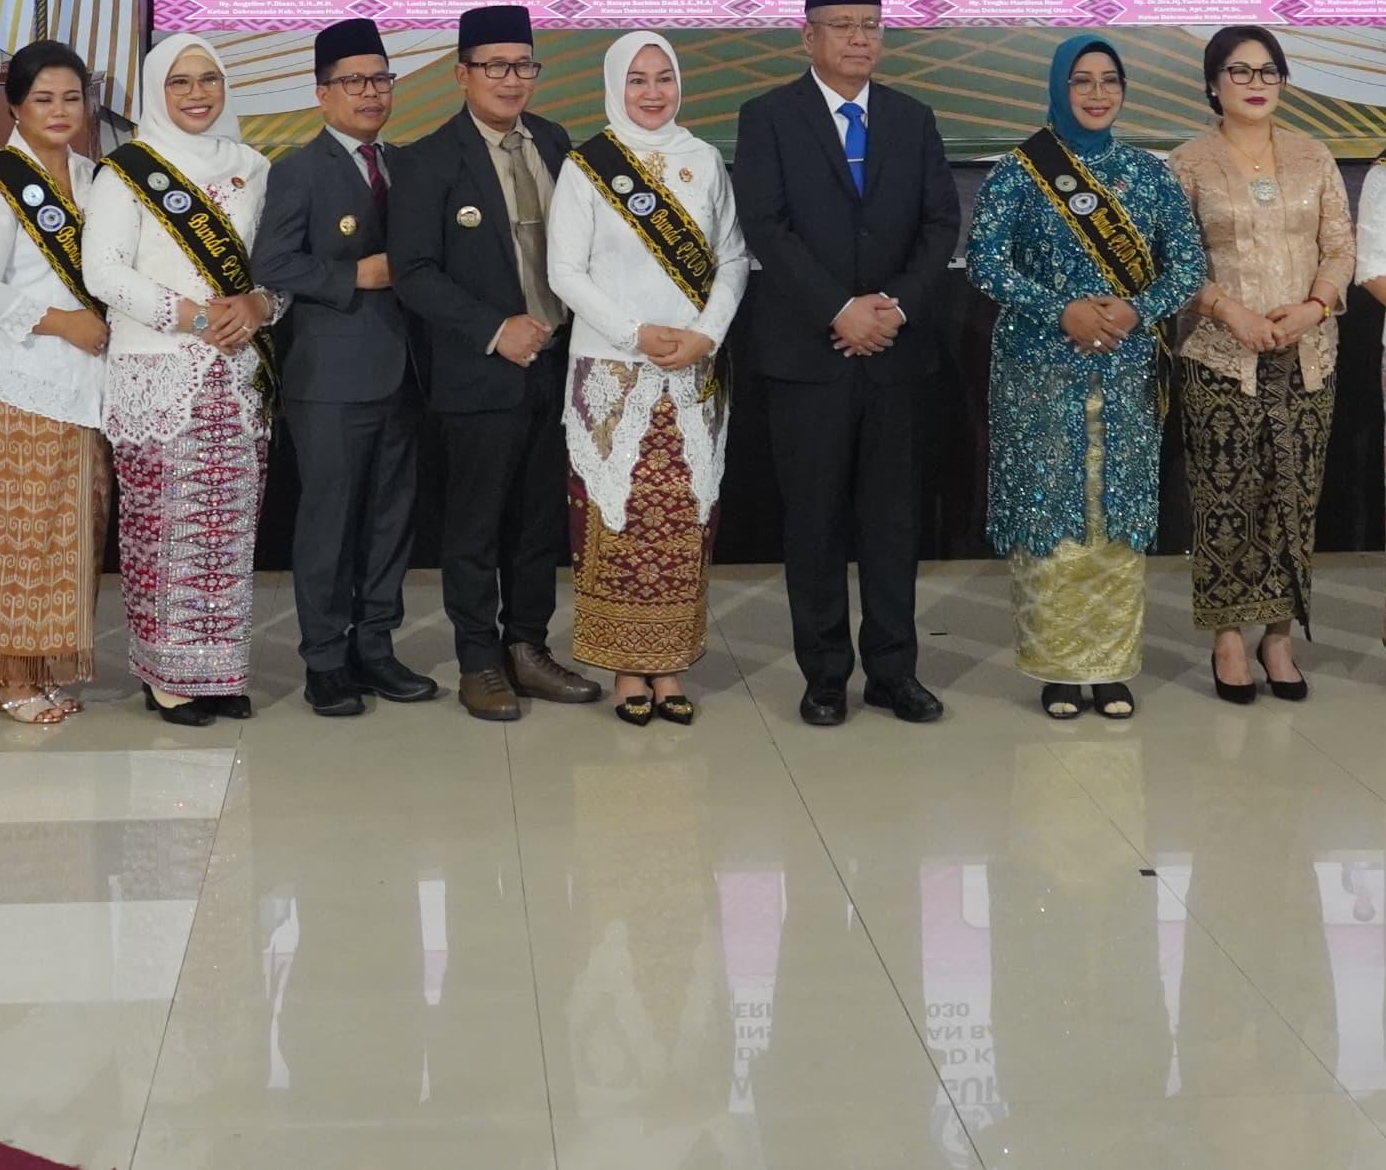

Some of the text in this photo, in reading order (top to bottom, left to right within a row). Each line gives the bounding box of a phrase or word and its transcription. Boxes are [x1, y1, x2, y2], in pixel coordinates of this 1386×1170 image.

[187, 212, 251, 294] Bunda PAU
[649, 208, 708, 278] Bunda PAUD
